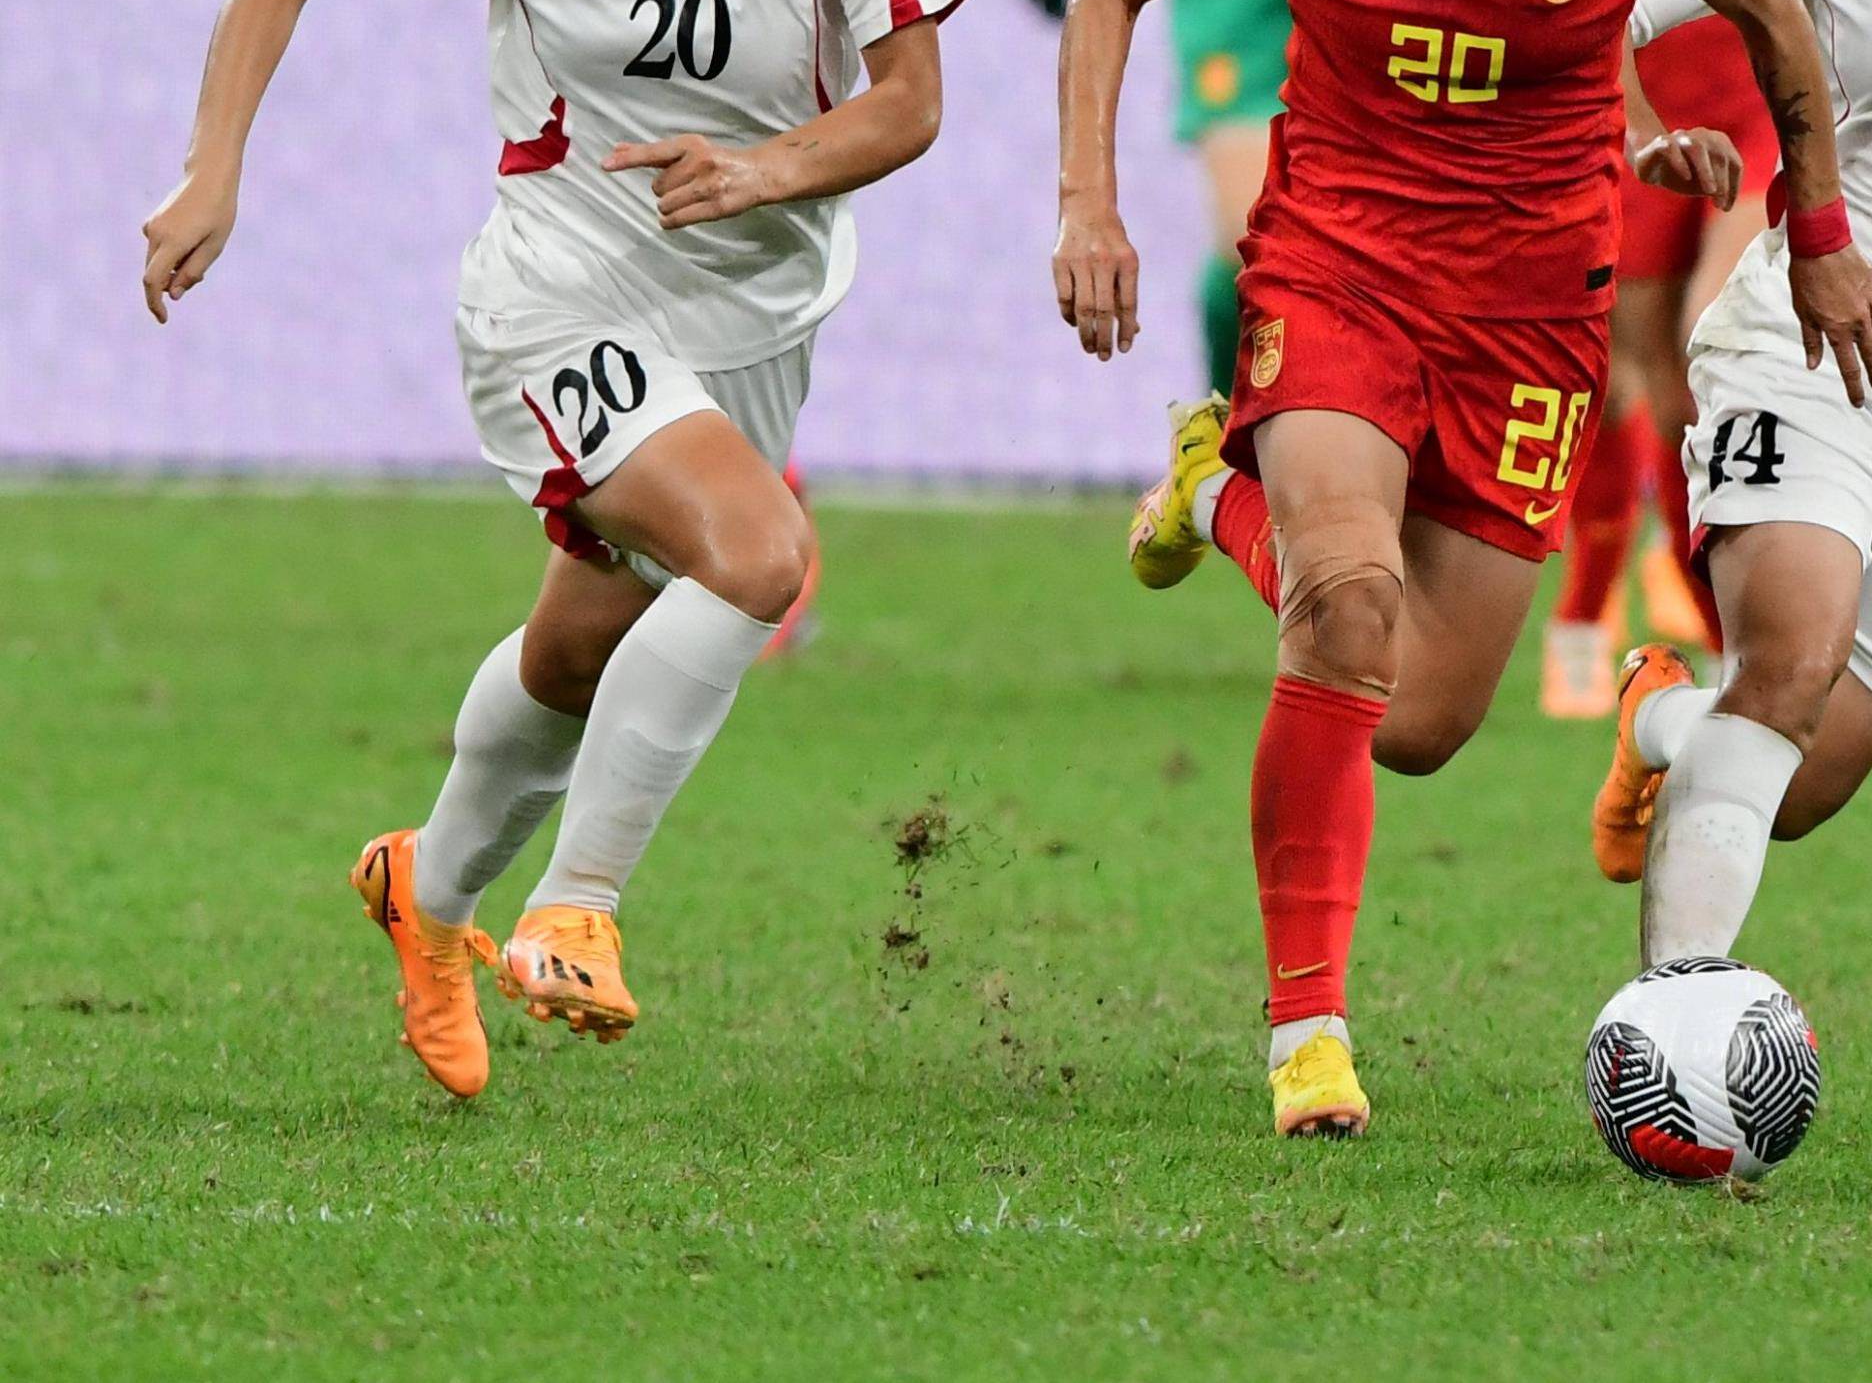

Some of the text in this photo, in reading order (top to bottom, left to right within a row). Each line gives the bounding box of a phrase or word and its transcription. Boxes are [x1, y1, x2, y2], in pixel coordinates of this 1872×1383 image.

[1386, 22, 1506, 104] 20
[551, 339, 647, 459] 20
[1708, 410, 1785, 494] 14
